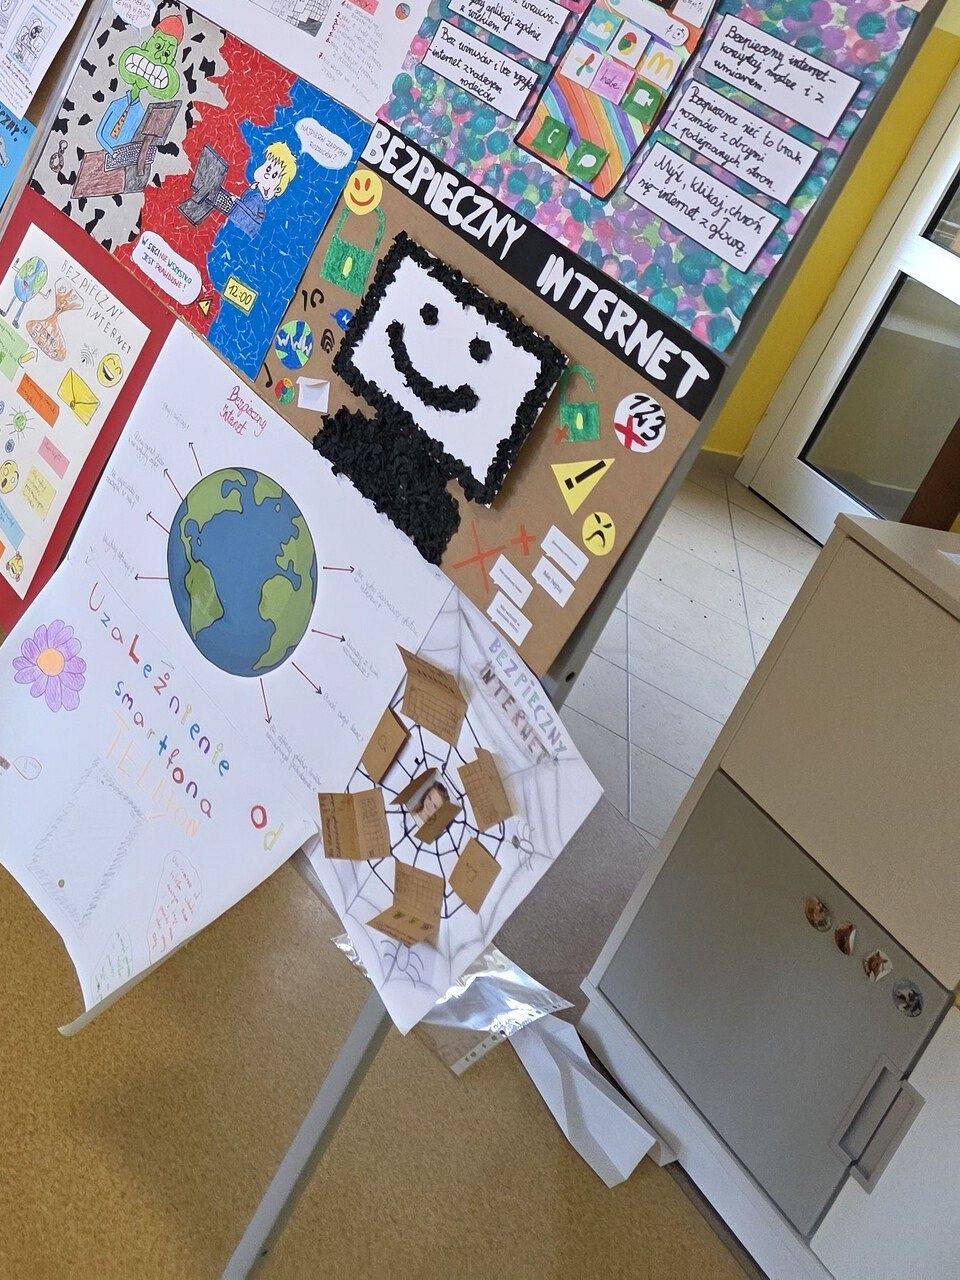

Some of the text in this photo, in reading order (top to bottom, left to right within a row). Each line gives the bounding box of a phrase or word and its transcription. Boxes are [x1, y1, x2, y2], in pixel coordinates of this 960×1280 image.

[440, 27, 456, 46] Bez
[763, 133, 775, 147] to
[777, 141, 802, 165] brak
[729, 204, 764, 235] chroń
[142, 251, 155, 265] JEST
[359, 124, 711, 400] BEZPIECZNY INTERNET
[60, 257, 127, 322] BEZPIECZNY
[228, 284, 253, 306] 12:00
[84, 305, 134, 355] INTERNET
[628, 392, 668, 441] 123
[113, 679, 214, 821] smartfona
